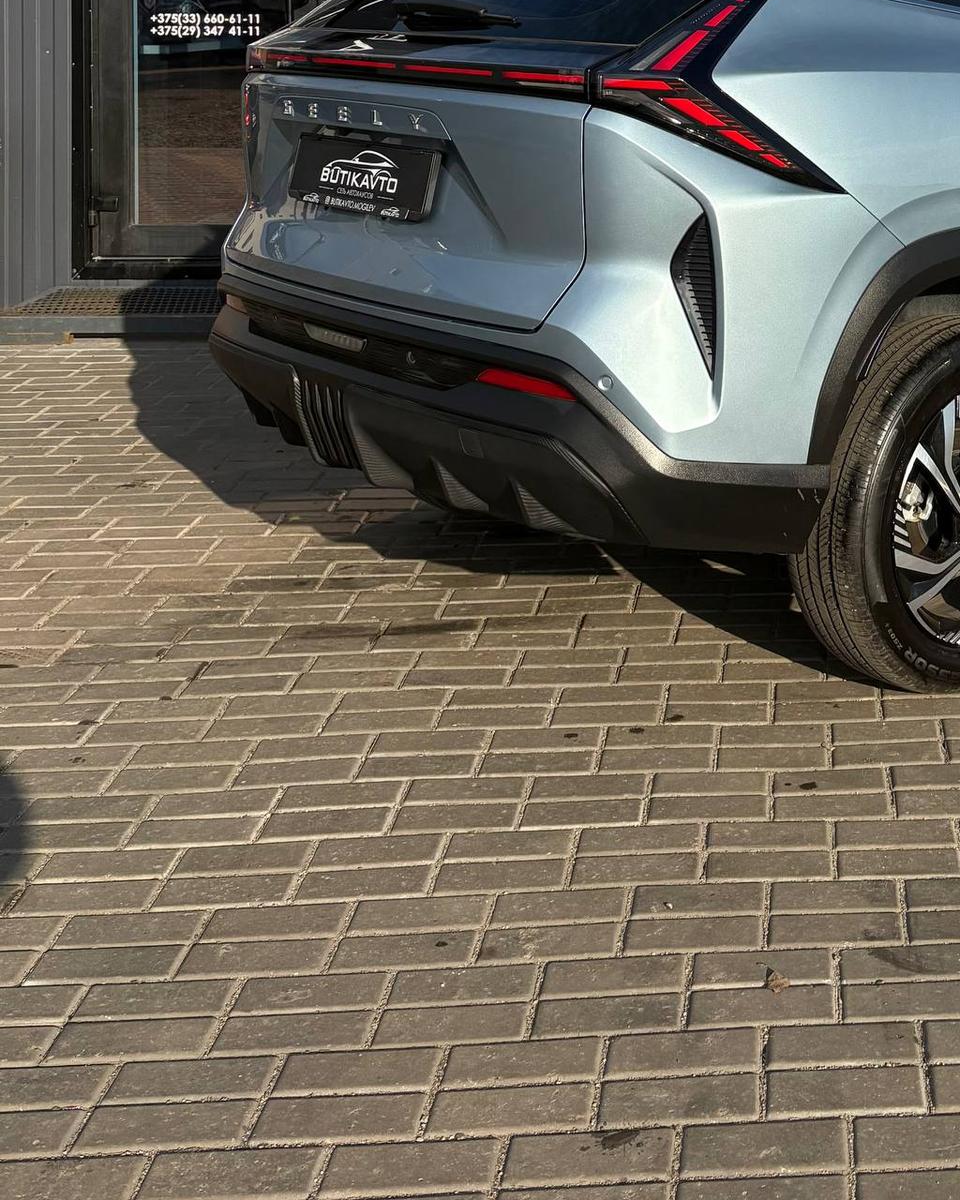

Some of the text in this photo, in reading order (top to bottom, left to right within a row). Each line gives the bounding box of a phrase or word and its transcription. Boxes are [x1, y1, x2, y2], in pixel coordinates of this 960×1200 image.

[150, 13, 260, 26] +375(33) 660-61-11
[150, 25, 201, 38] +375(29)
[283, 100, 424, 130] GEELY
[319, 166, 399, 193] BUTIKAVTO
